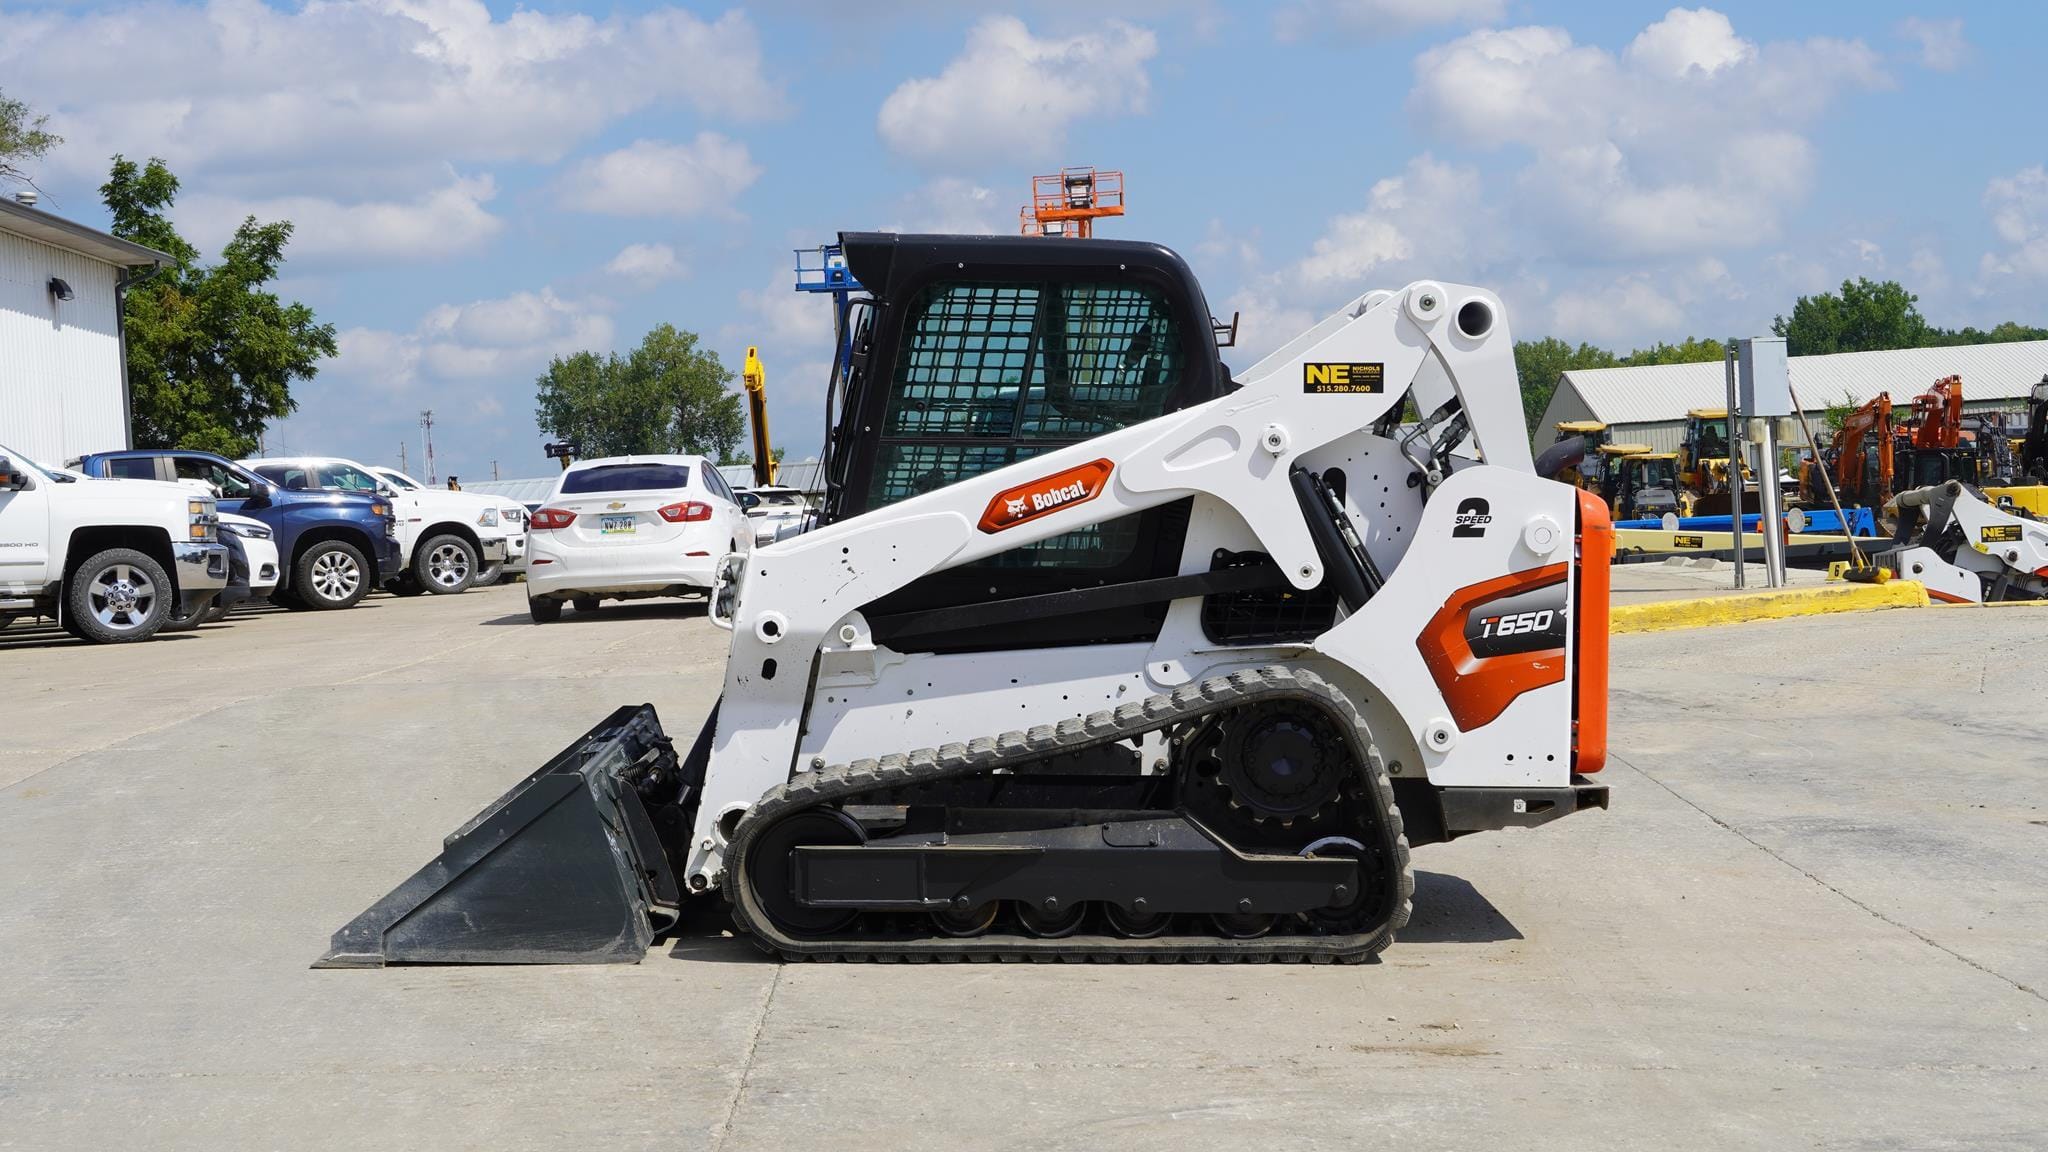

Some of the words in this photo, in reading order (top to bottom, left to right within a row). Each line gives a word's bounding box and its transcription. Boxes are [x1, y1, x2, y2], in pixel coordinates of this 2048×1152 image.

[1307, 365, 1350, 384] NE
[1316, 385, 1371, 393] 515.280.7600
[1031, 480, 1086, 511] Bobcat
[1452, 497, 1490, 538] 2
[1455, 515, 1492, 524] SPEED
[1982, 527, 2005, 538] NE
[1675, 536, 1691, 545] NE
[1834, 564, 1840, 577] 6
[1480, 609, 1554, 639] T650
